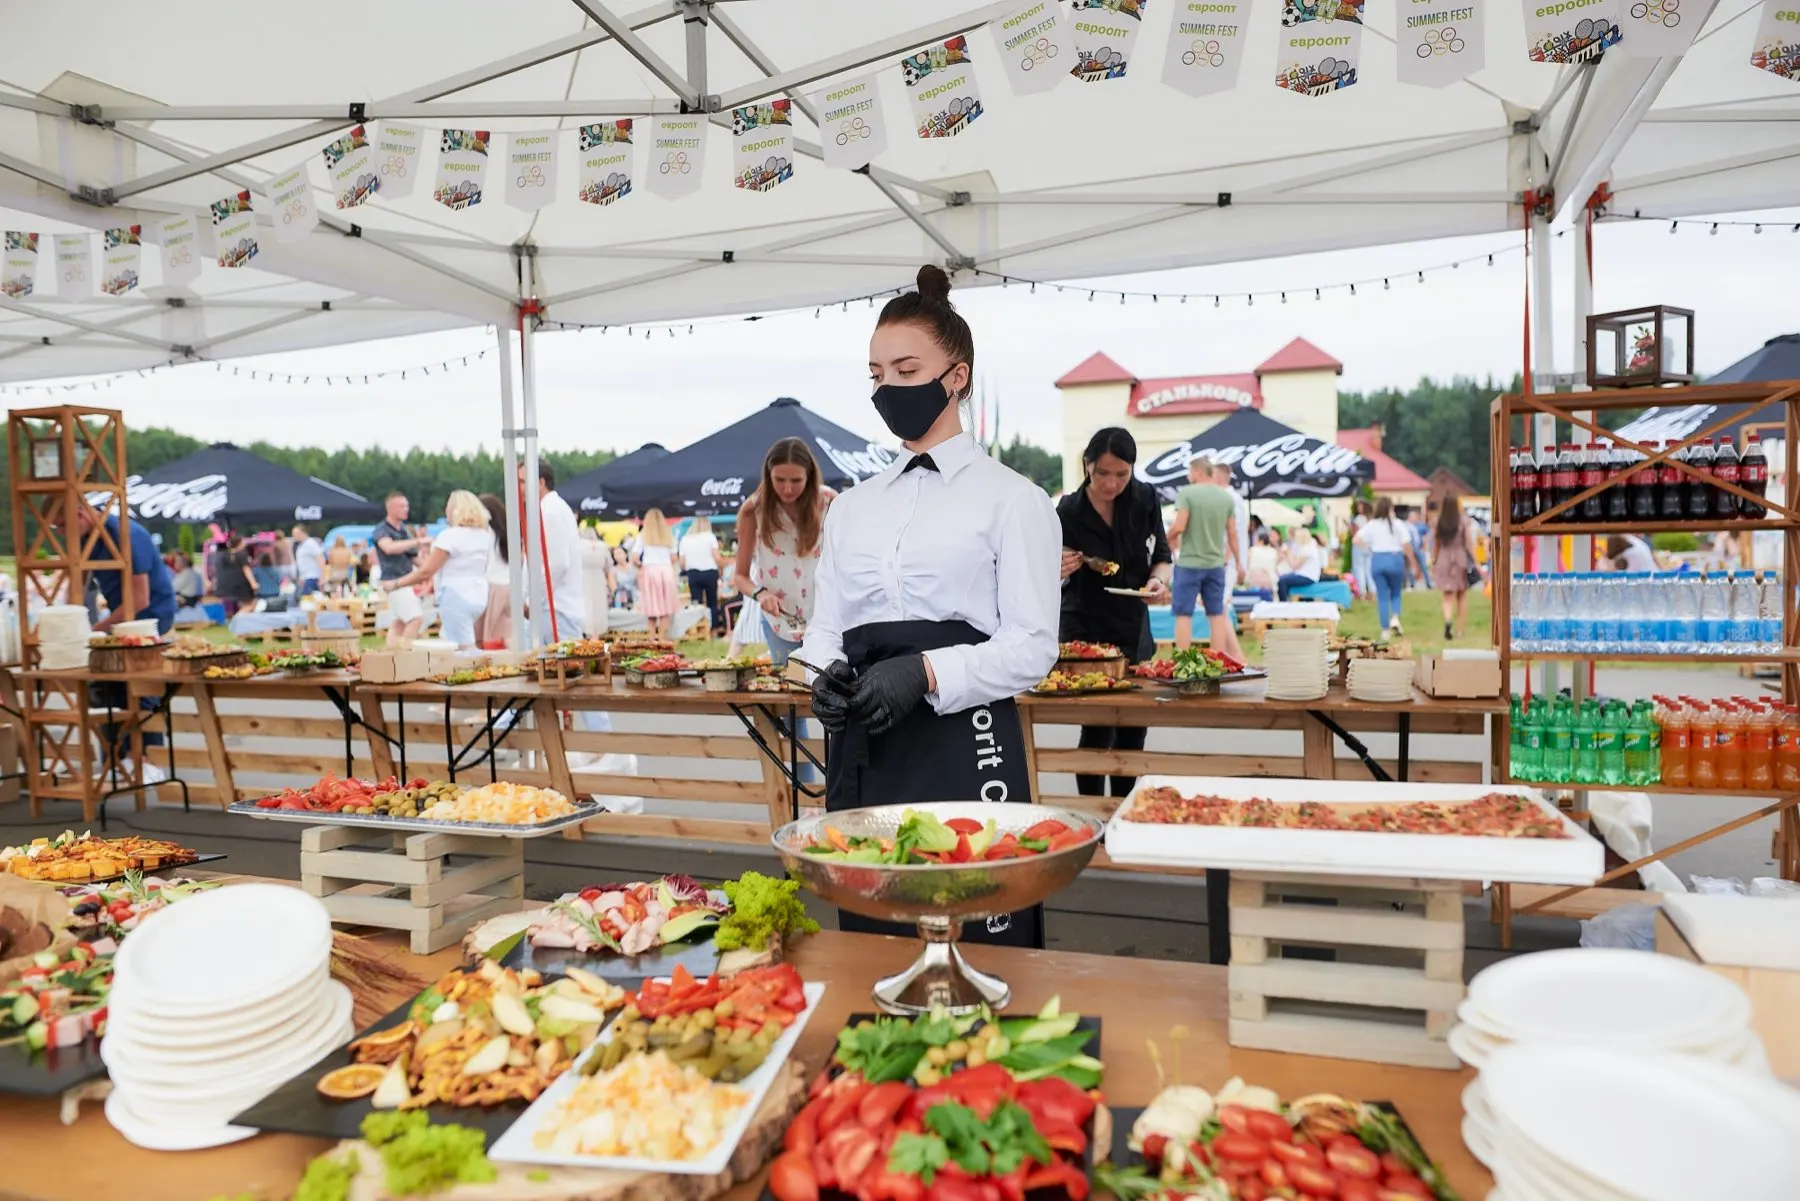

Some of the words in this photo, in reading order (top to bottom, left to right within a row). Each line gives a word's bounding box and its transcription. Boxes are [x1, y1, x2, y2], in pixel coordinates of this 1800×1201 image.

[1002, 3, 1045, 29] евроопт
[1187, 3, 1237, 14] евроопт
[1407, 11, 1448, 28] SUMMER
[1450, 7, 1474, 21] FEST
[1004, 27, 1038, 51] SUMMER
[1037, 15, 1056, 34] FEST
[1074, 21, 1130, 38] евроопт
[1179, 22, 1216, 36] SUMMER
[1216, 24, 1238, 37] FEST
[1288, 36, 1351, 48] евроопт
[825, 83, 866, 101] евроопт
[917, 75, 967, 102] евроопт
[824, 104, 856, 122] SUMMER
[856, 98, 873, 112] FEST
[656, 138, 683, 149] SUMMER
[684, 138, 700, 149] FEST
[741, 136, 785, 153] евроопт
[972, 703, 1003, 770] orit
